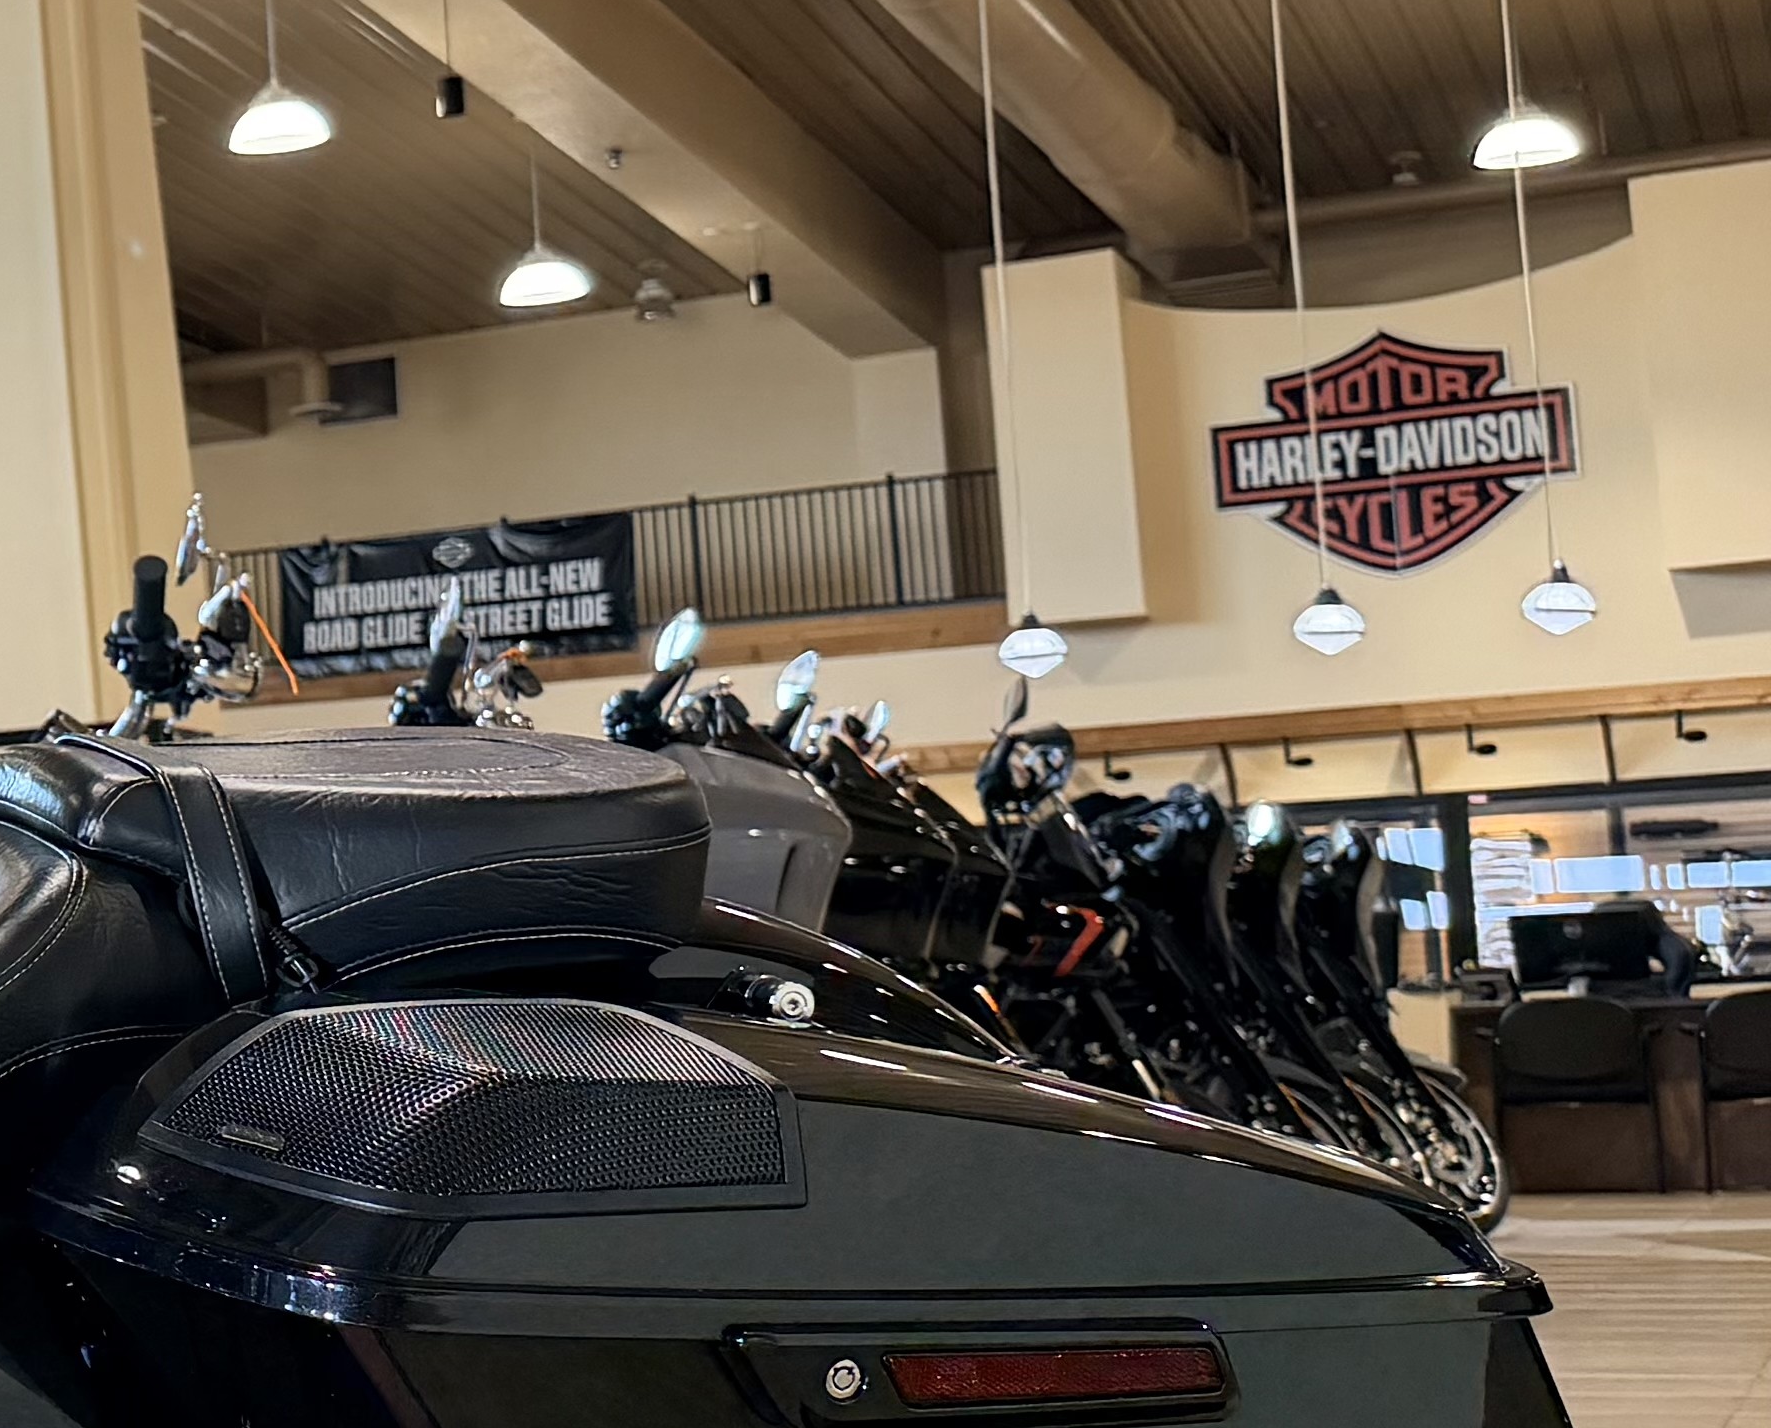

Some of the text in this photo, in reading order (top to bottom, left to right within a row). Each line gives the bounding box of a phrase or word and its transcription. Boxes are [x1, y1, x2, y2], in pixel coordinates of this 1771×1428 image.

[1305, 354, 1468, 419] MOTOR
[1234, 408, 1547, 490] HARLEY-DAVIDSON
[1312, 480, 1479, 554] CYCLES
[458, 568, 502, 604] THE
[505, 557, 602, 599] ALL-NEW
[304, 619, 360, 654] ROAD
[362, 611, 424, 652] GLIDE
[463, 600, 544, 638] STREET
[546, 592, 611, 631] GLIDE
